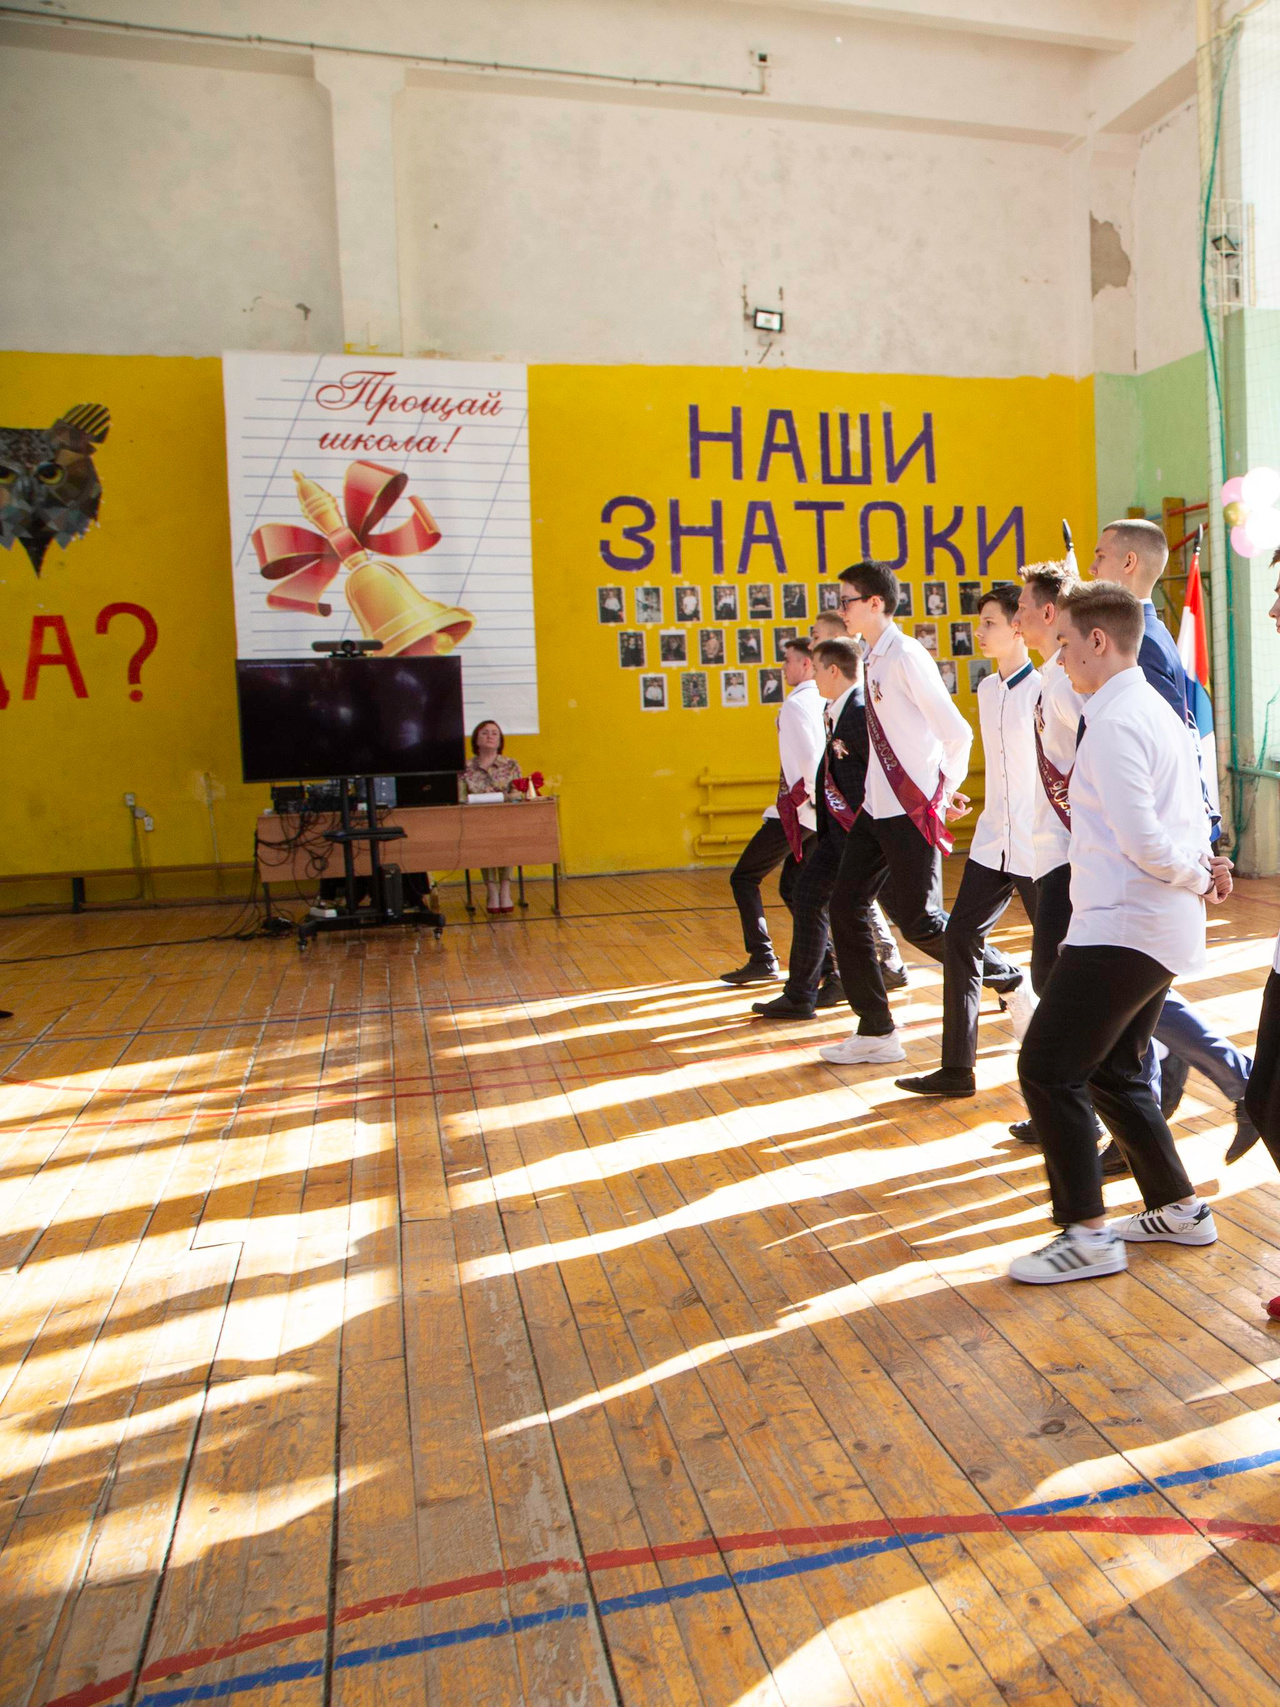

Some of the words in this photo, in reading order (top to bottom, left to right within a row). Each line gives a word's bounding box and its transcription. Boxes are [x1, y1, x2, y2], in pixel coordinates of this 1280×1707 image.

[316, 371, 502, 426] Прощай
[318, 426, 462, 453] школа!
[688, 404, 936, 485] НАШИ
[600, 495, 1026, 576] ЗНАТОКИ
[0, 602, 158, 710] А?
